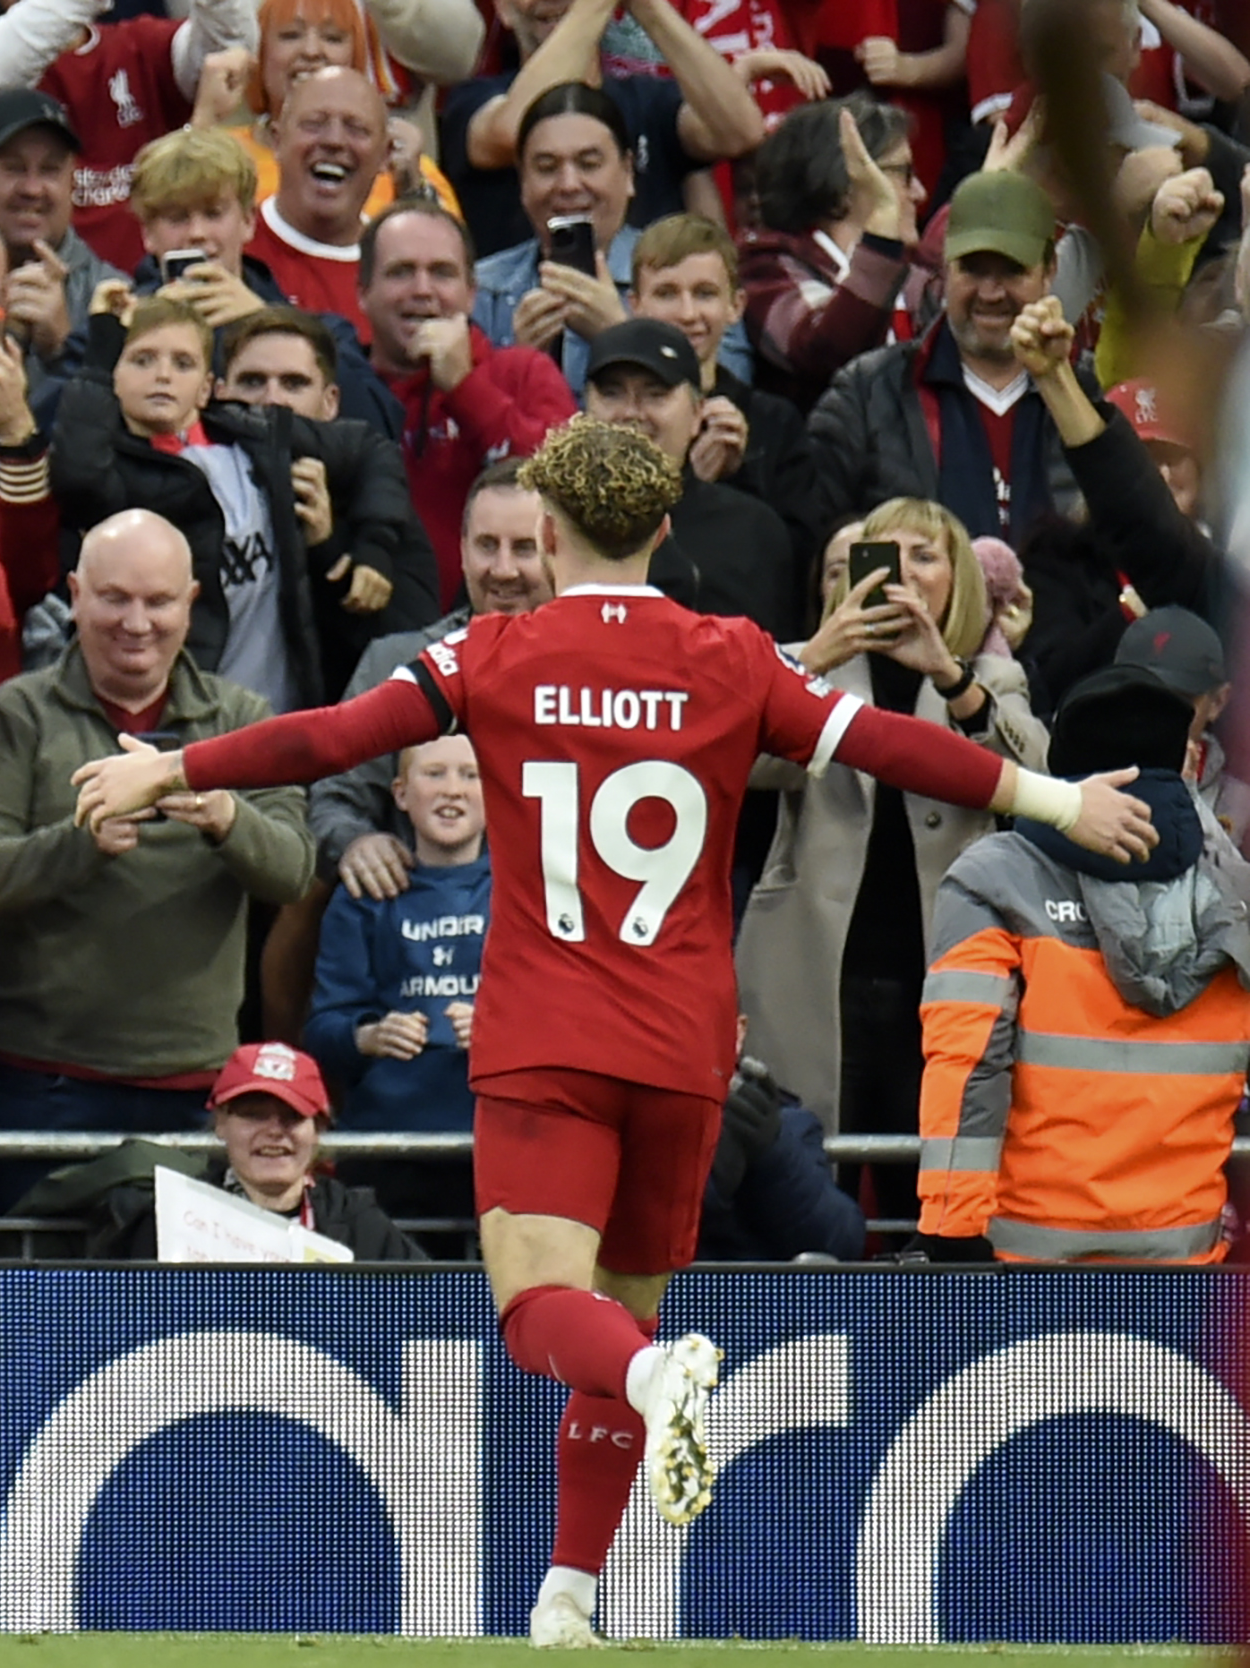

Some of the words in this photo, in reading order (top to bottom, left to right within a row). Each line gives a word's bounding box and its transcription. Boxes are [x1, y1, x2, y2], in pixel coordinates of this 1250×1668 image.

[534, 685, 689, 731] ELLIOTT
[522, 760, 708, 947] 19
[399, 974, 482, 998] ARMOU
[567, 1421, 634, 1450] LFC
